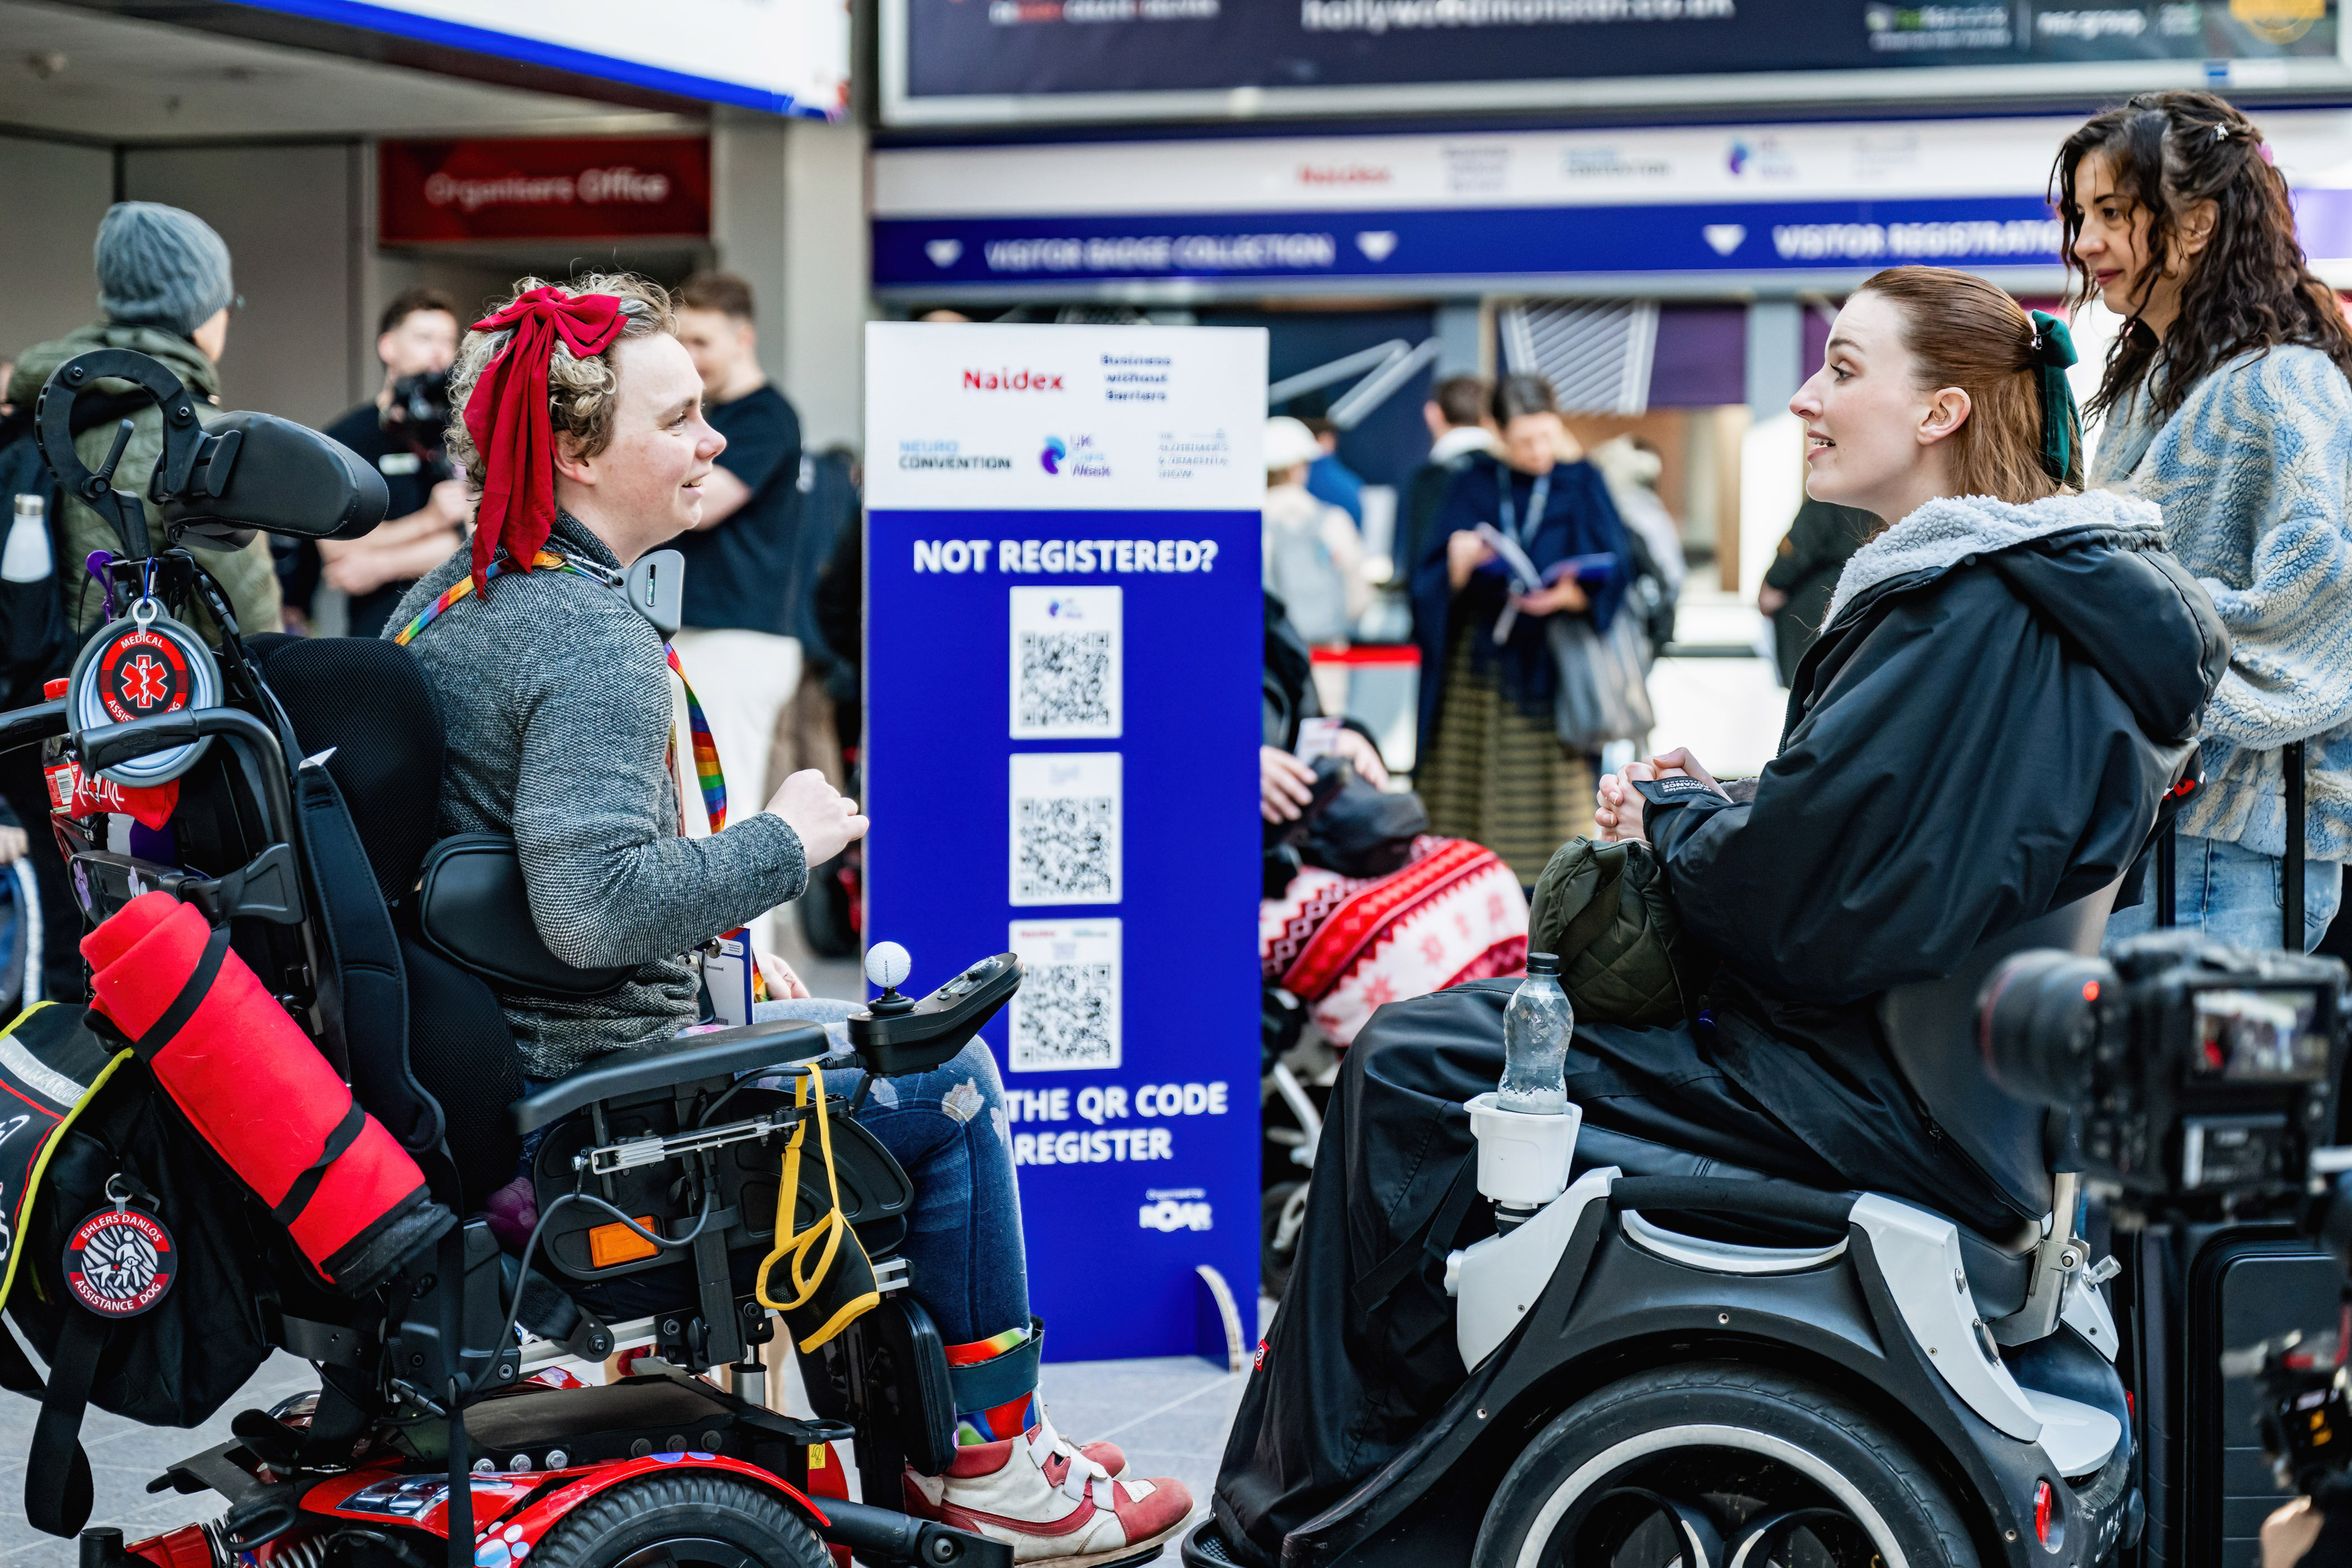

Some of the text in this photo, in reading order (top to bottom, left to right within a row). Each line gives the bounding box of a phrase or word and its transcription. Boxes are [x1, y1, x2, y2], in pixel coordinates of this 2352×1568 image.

[424, 167, 669, 212] Organisers Office
[984, 233, 1336, 272] VISITOR BADGE COLLECTION
[1772, 224, 1886, 260] VISITOR
[964, 367, 1064, 390] Naidex
[898, 456, 1012, 470] CONVENTION
[914, 539, 1219, 573] NOT REGISTERED?
[120, 634, 163, 649] MEDICAL
[1005, 1081, 1229, 1125] THE QR CODE
[1014, 1127, 1173, 1166] REGISTER
[80, 1214, 163, 1242] EHLERS DANLOS
[74, 1280, 162, 1311] ASSISTANCE DOG
